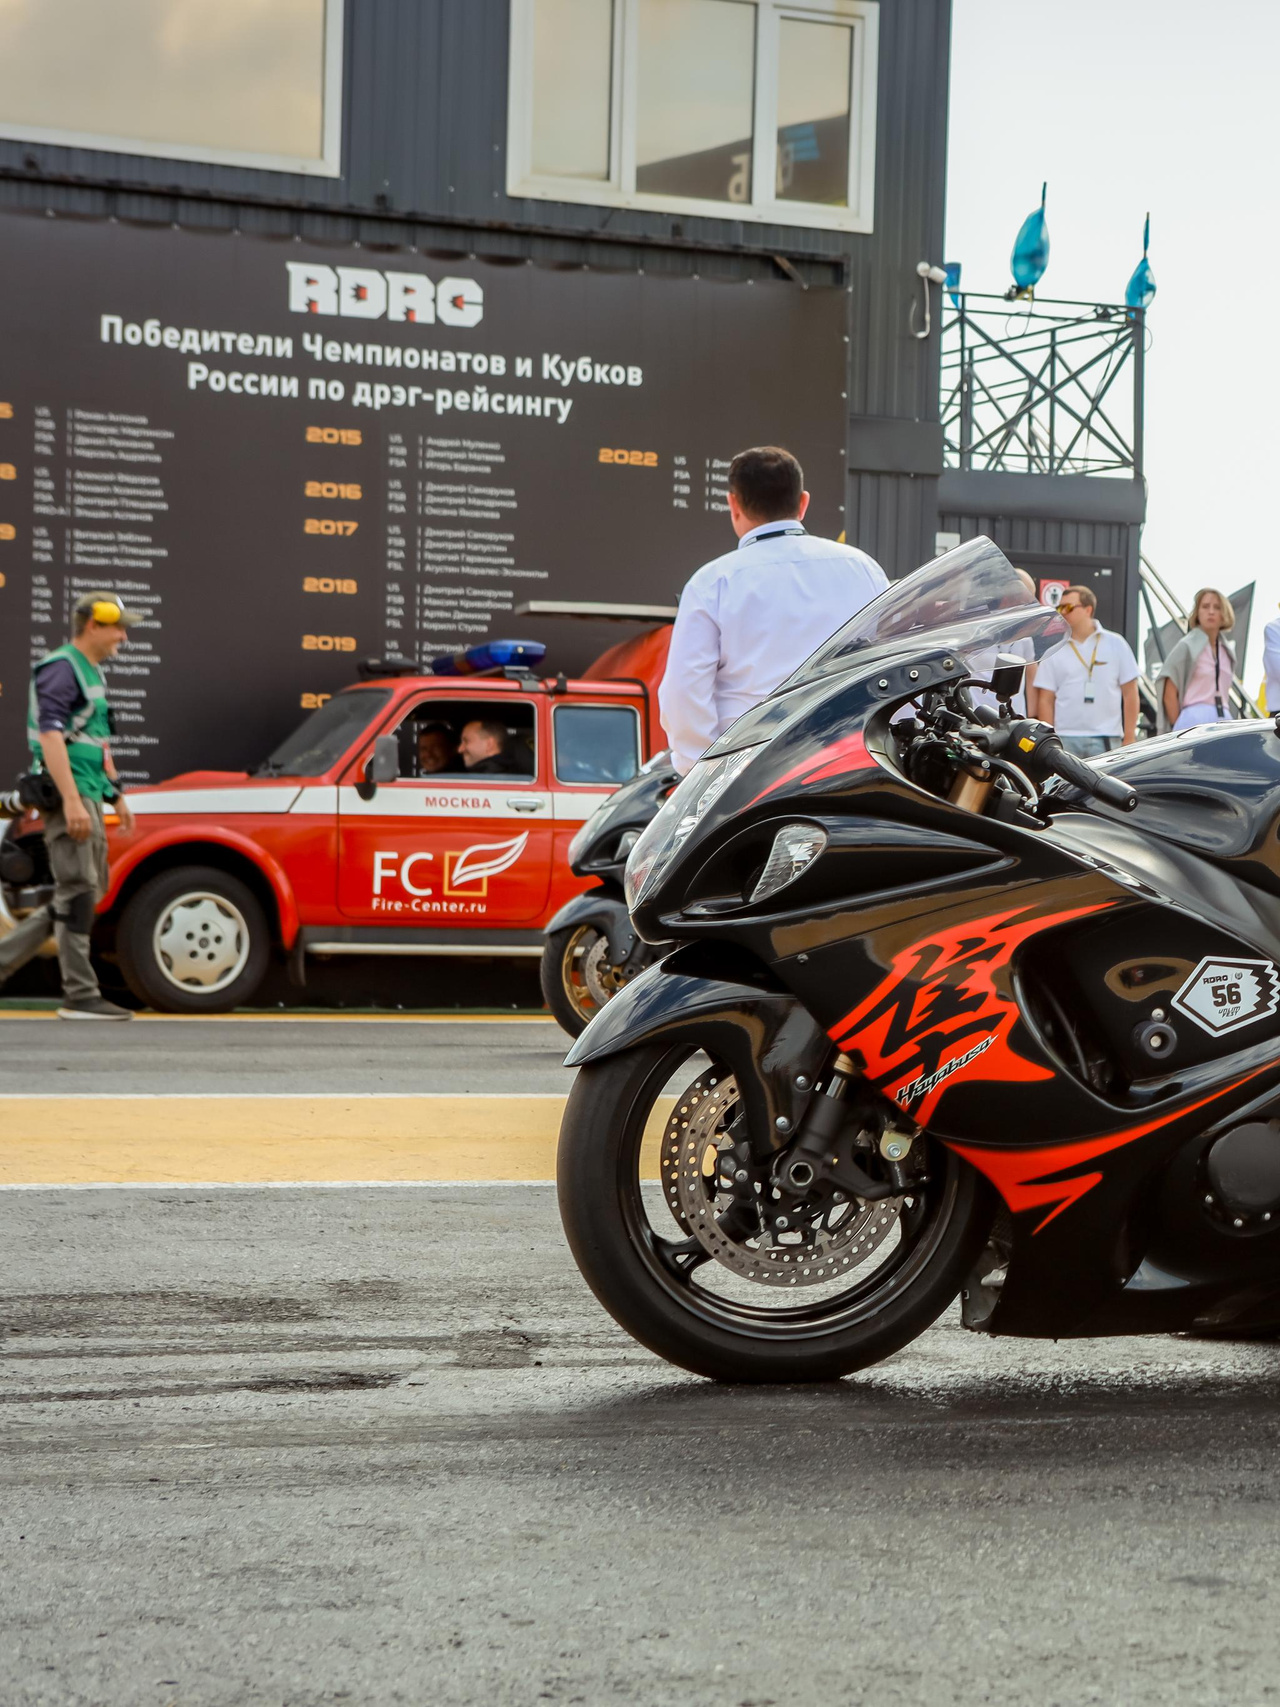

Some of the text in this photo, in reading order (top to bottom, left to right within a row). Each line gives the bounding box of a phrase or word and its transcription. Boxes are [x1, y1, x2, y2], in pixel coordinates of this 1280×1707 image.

[286, 261, 483, 328] RDRC
[100, 314, 643, 387] Победители Чемпионатов и Кубков
[188, 361, 573, 424] России по дрэг-рейсингу
[306, 426, 362, 446] 2015
[598, 448, 658, 467] 2022
[674, 456, 686, 466] US
[305, 481, 362, 500] 2016
[304, 519, 359, 536] 2017
[303, 577, 358, 594] 2018
[302, 634, 357, 652] 2019
[425, 796, 491, 809] МОСКВА
[373, 851, 434, 896] FC
[372, 897, 487, 913] Fire-Center.ru
[1211, 982, 1241, 1007] 56
[894, 1034, 999, 1106] Hayabusa
